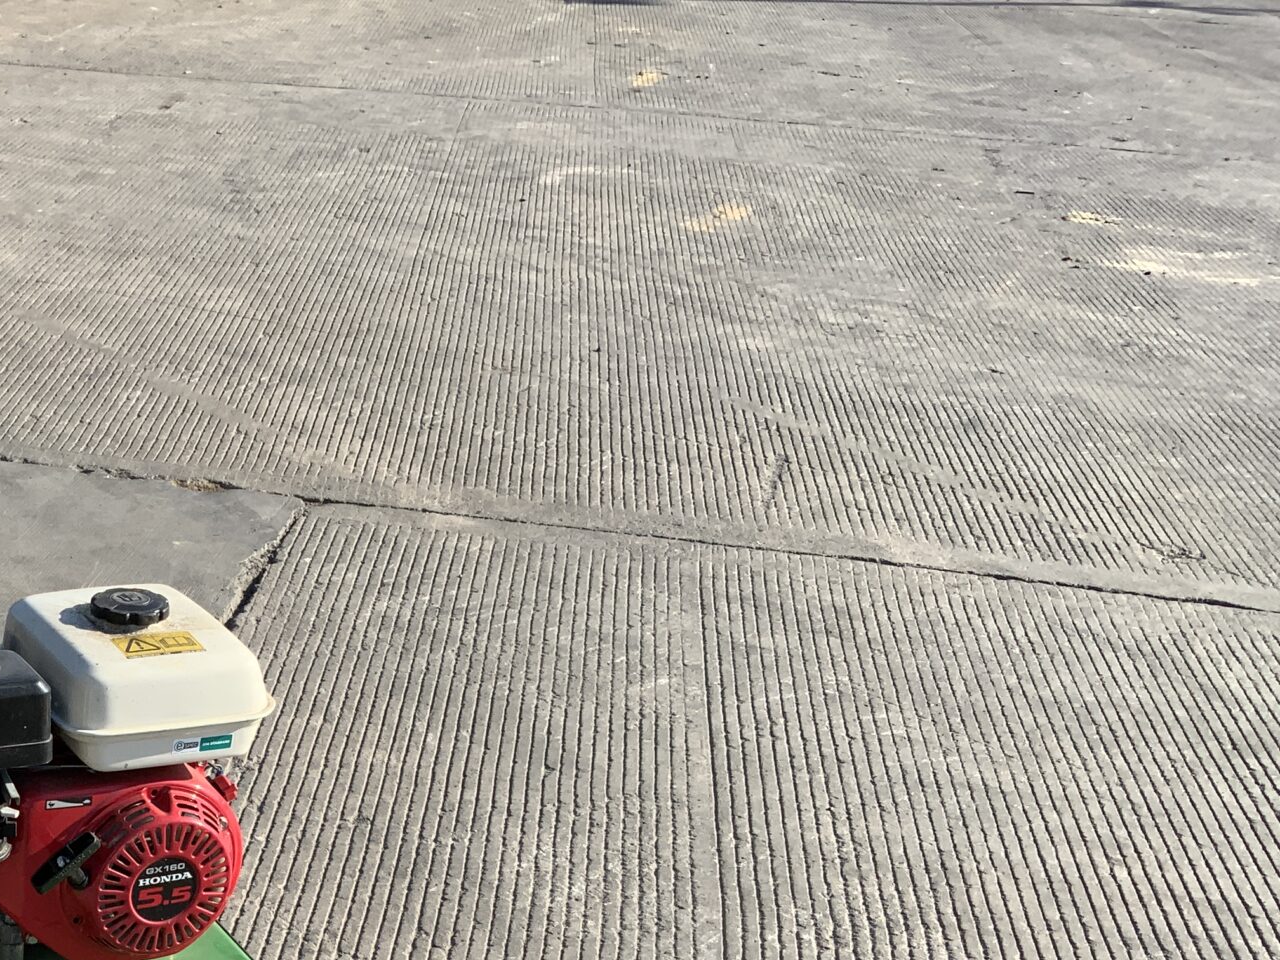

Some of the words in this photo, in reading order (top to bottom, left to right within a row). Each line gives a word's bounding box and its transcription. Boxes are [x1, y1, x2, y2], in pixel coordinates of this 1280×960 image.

[145, 862, 186, 875] GX160
[138, 871, 193, 887] HONDA
[136, 886, 192, 910] 5.5
